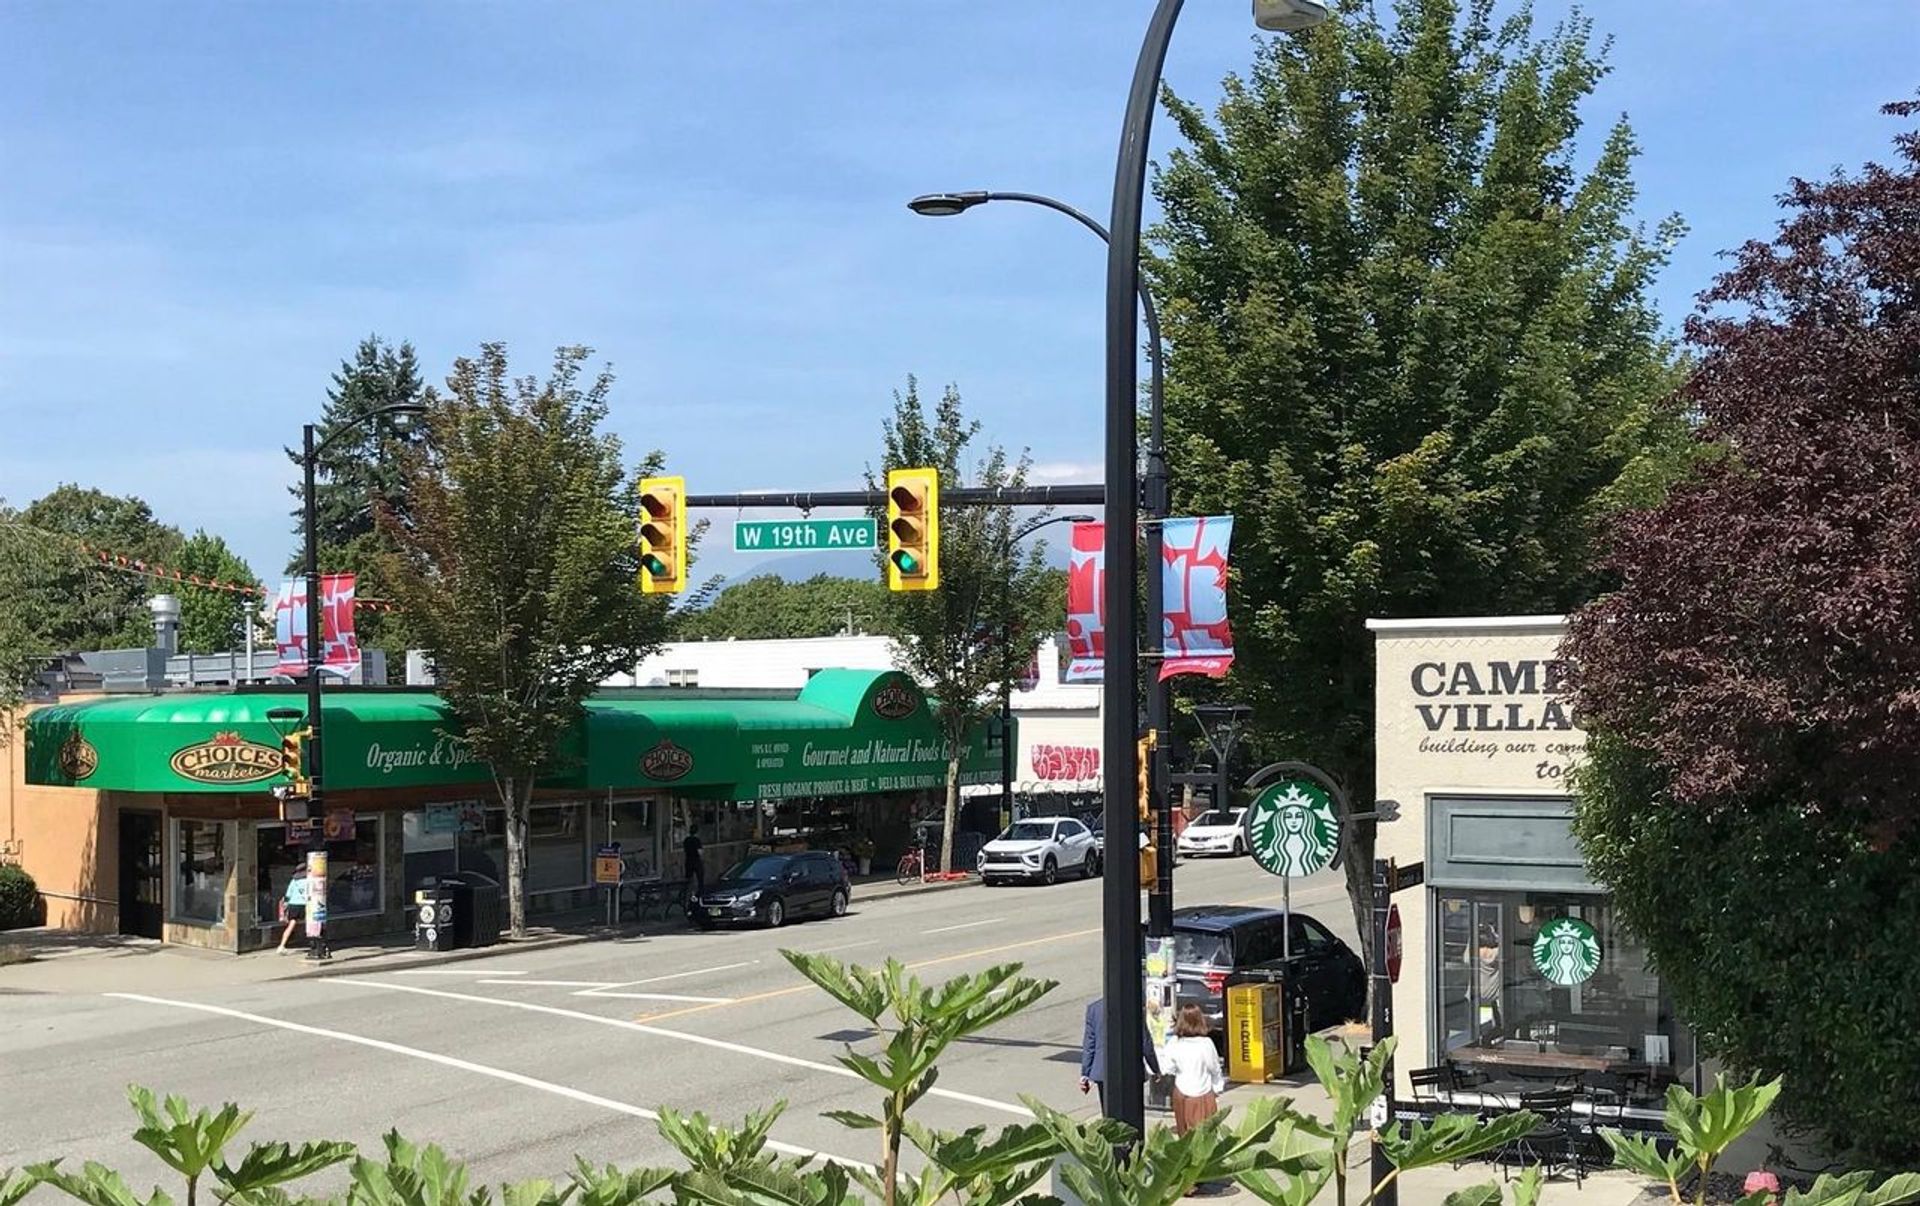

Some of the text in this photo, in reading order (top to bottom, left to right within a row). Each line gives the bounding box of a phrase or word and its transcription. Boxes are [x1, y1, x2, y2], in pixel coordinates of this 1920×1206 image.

[742, 524, 869, 547] W 19th Ave
[180, 746, 280, 769] CHOICES
[366, 742, 427, 773] Organic
[429, 740, 443, 765] &
[802, 741, 850, 767] Gourmet
[850, 740, 873, 765] and
[872, 739, 911, 763] Natural
[912, 739, 939, 762] Foods
[1418, 736, 1499, 758] building
[1504, 742, 1536, 753] our
[195, 763, 264, 779] markets
[759, 783, 781, 798] FRESH
[782, 781, 812, 797] ORGANIC
[1241, 1020, 1250, 1062] FREE
